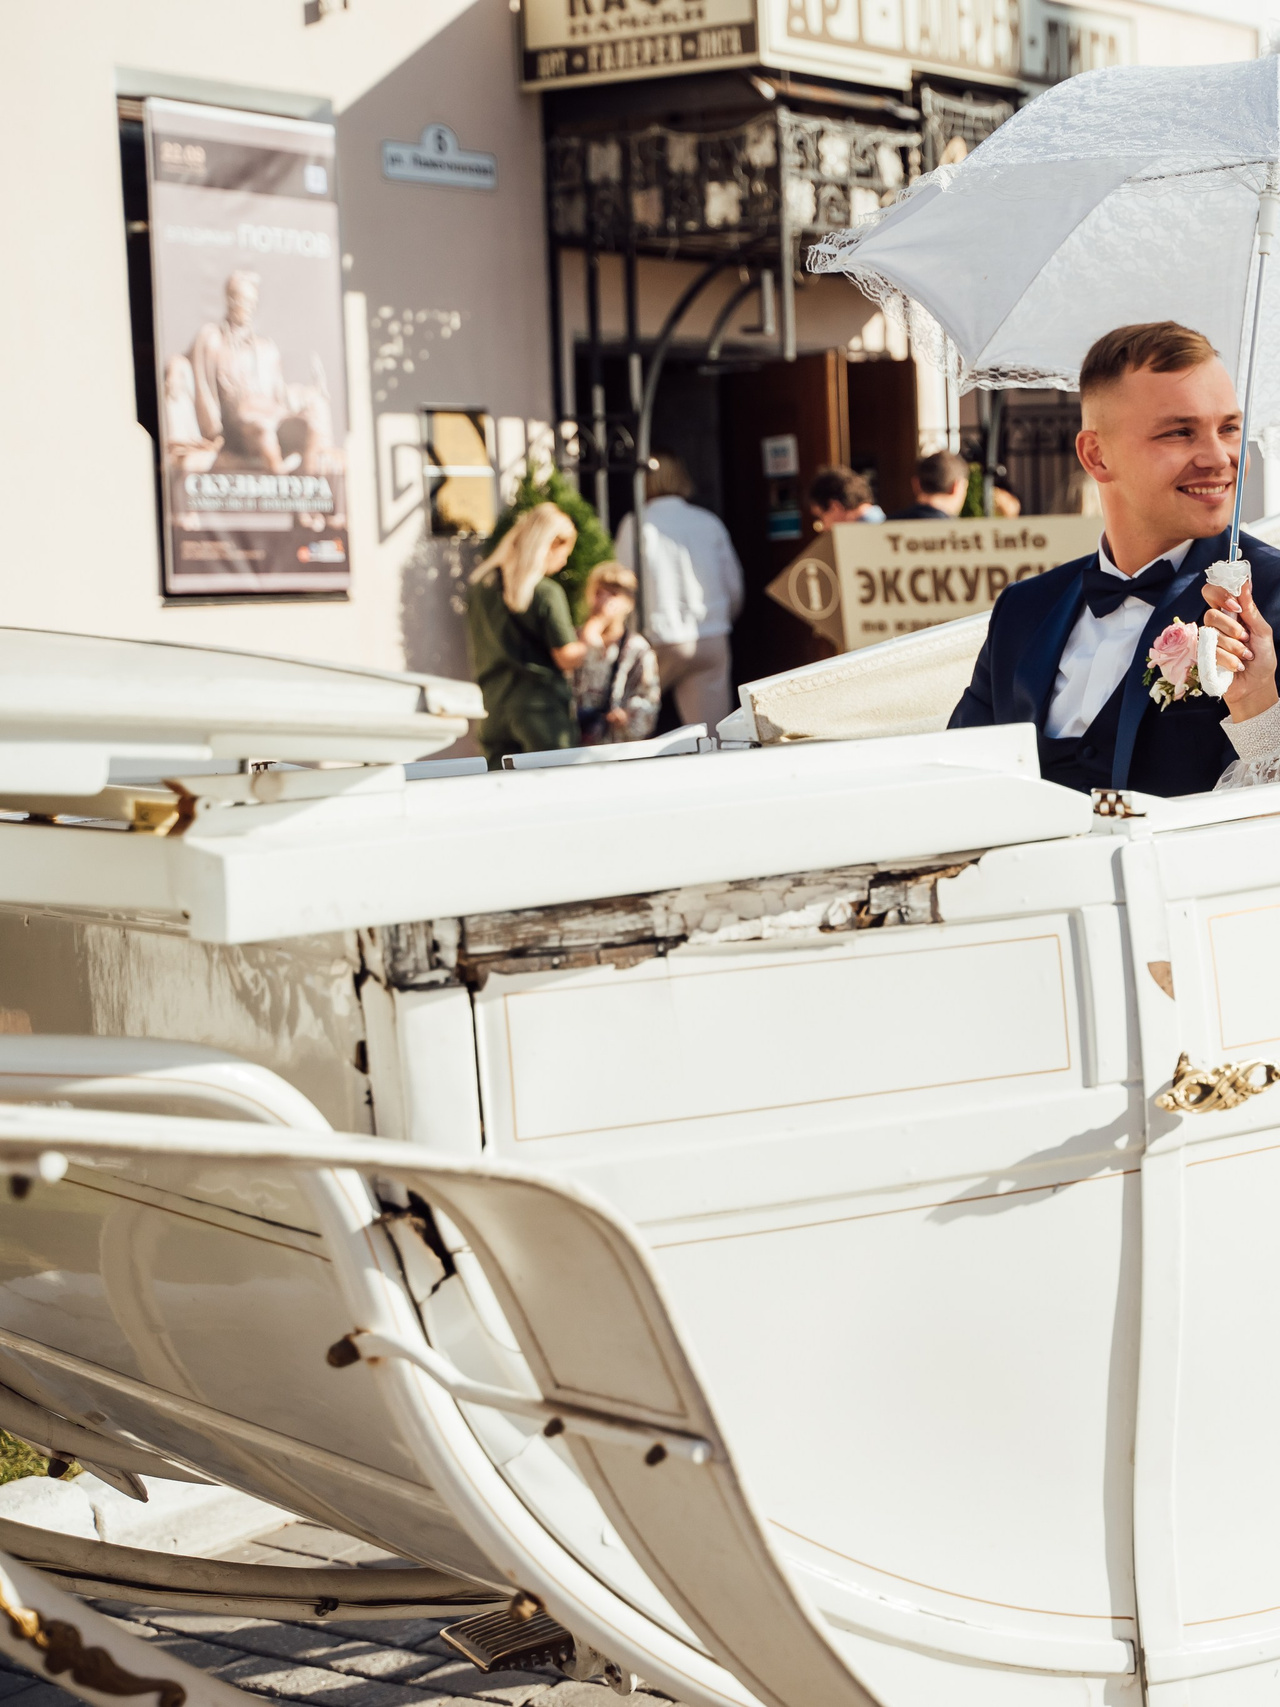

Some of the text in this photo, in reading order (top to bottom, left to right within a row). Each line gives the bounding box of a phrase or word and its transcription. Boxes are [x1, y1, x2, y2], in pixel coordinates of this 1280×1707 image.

[887, 528, 1047, 553] Tourist info
[856, 563, 1062, 604] ЭКСКУР
